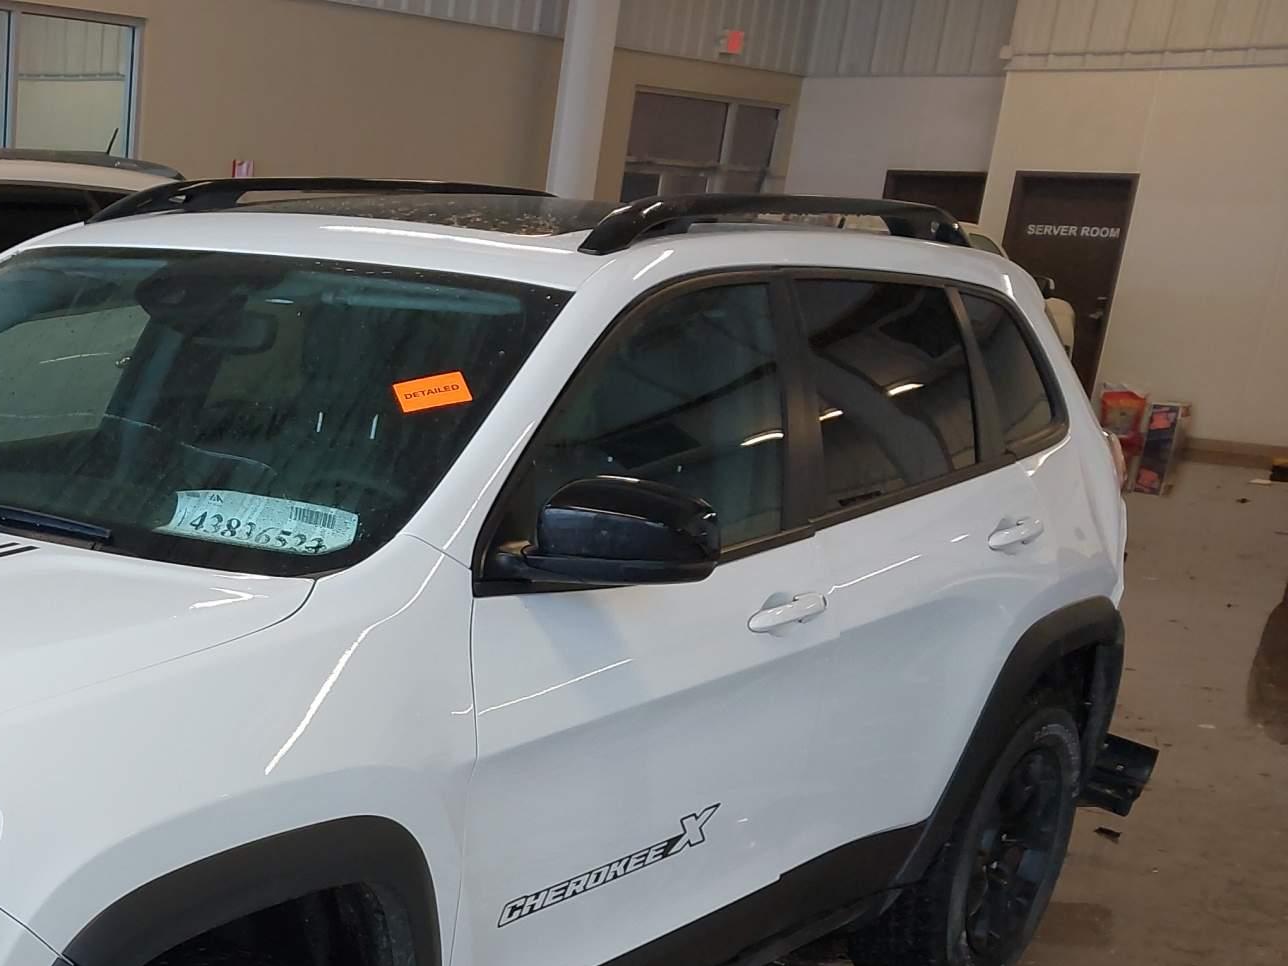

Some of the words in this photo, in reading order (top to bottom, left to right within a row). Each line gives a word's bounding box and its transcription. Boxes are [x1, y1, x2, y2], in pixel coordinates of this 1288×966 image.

[1027, 224, 1078, 236] SERVER
[1080, 226, 1121, 238] ROOM
[404, 383, 460, 400] DETAILED
[498, 838, 673, 928] CHEROKEE
[668, 803, 721, 856] X
